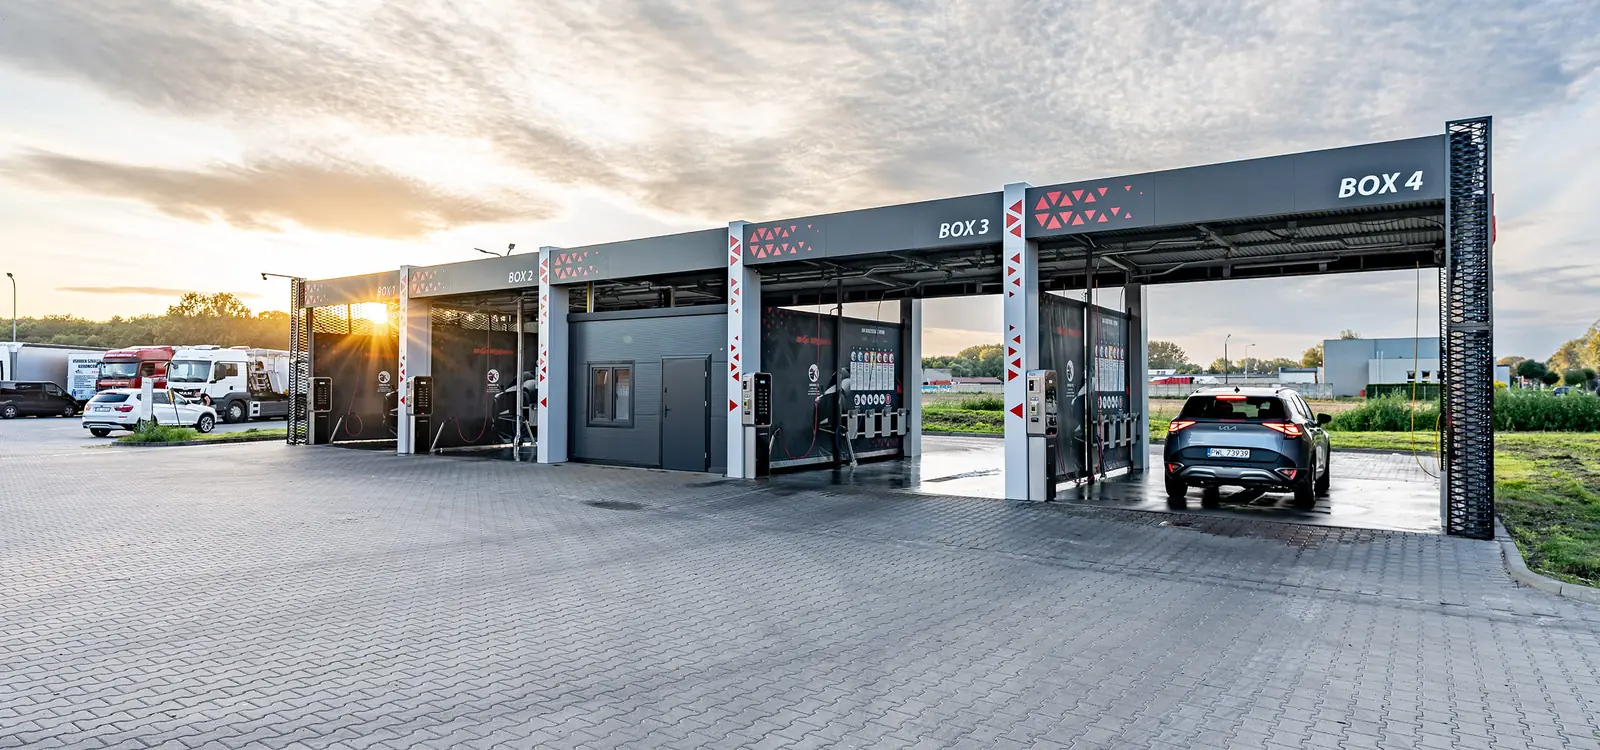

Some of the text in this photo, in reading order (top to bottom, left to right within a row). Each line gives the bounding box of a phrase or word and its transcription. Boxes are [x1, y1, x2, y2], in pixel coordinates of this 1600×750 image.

[1338, 170, 1424, 199] BOX 4
[938, 218, 990, 239] BOX 3
[508, 270, 533, 283] BOX 2
[377, 285, 392, 297] BOX
[1226, 449, 1249, 457] 73939
